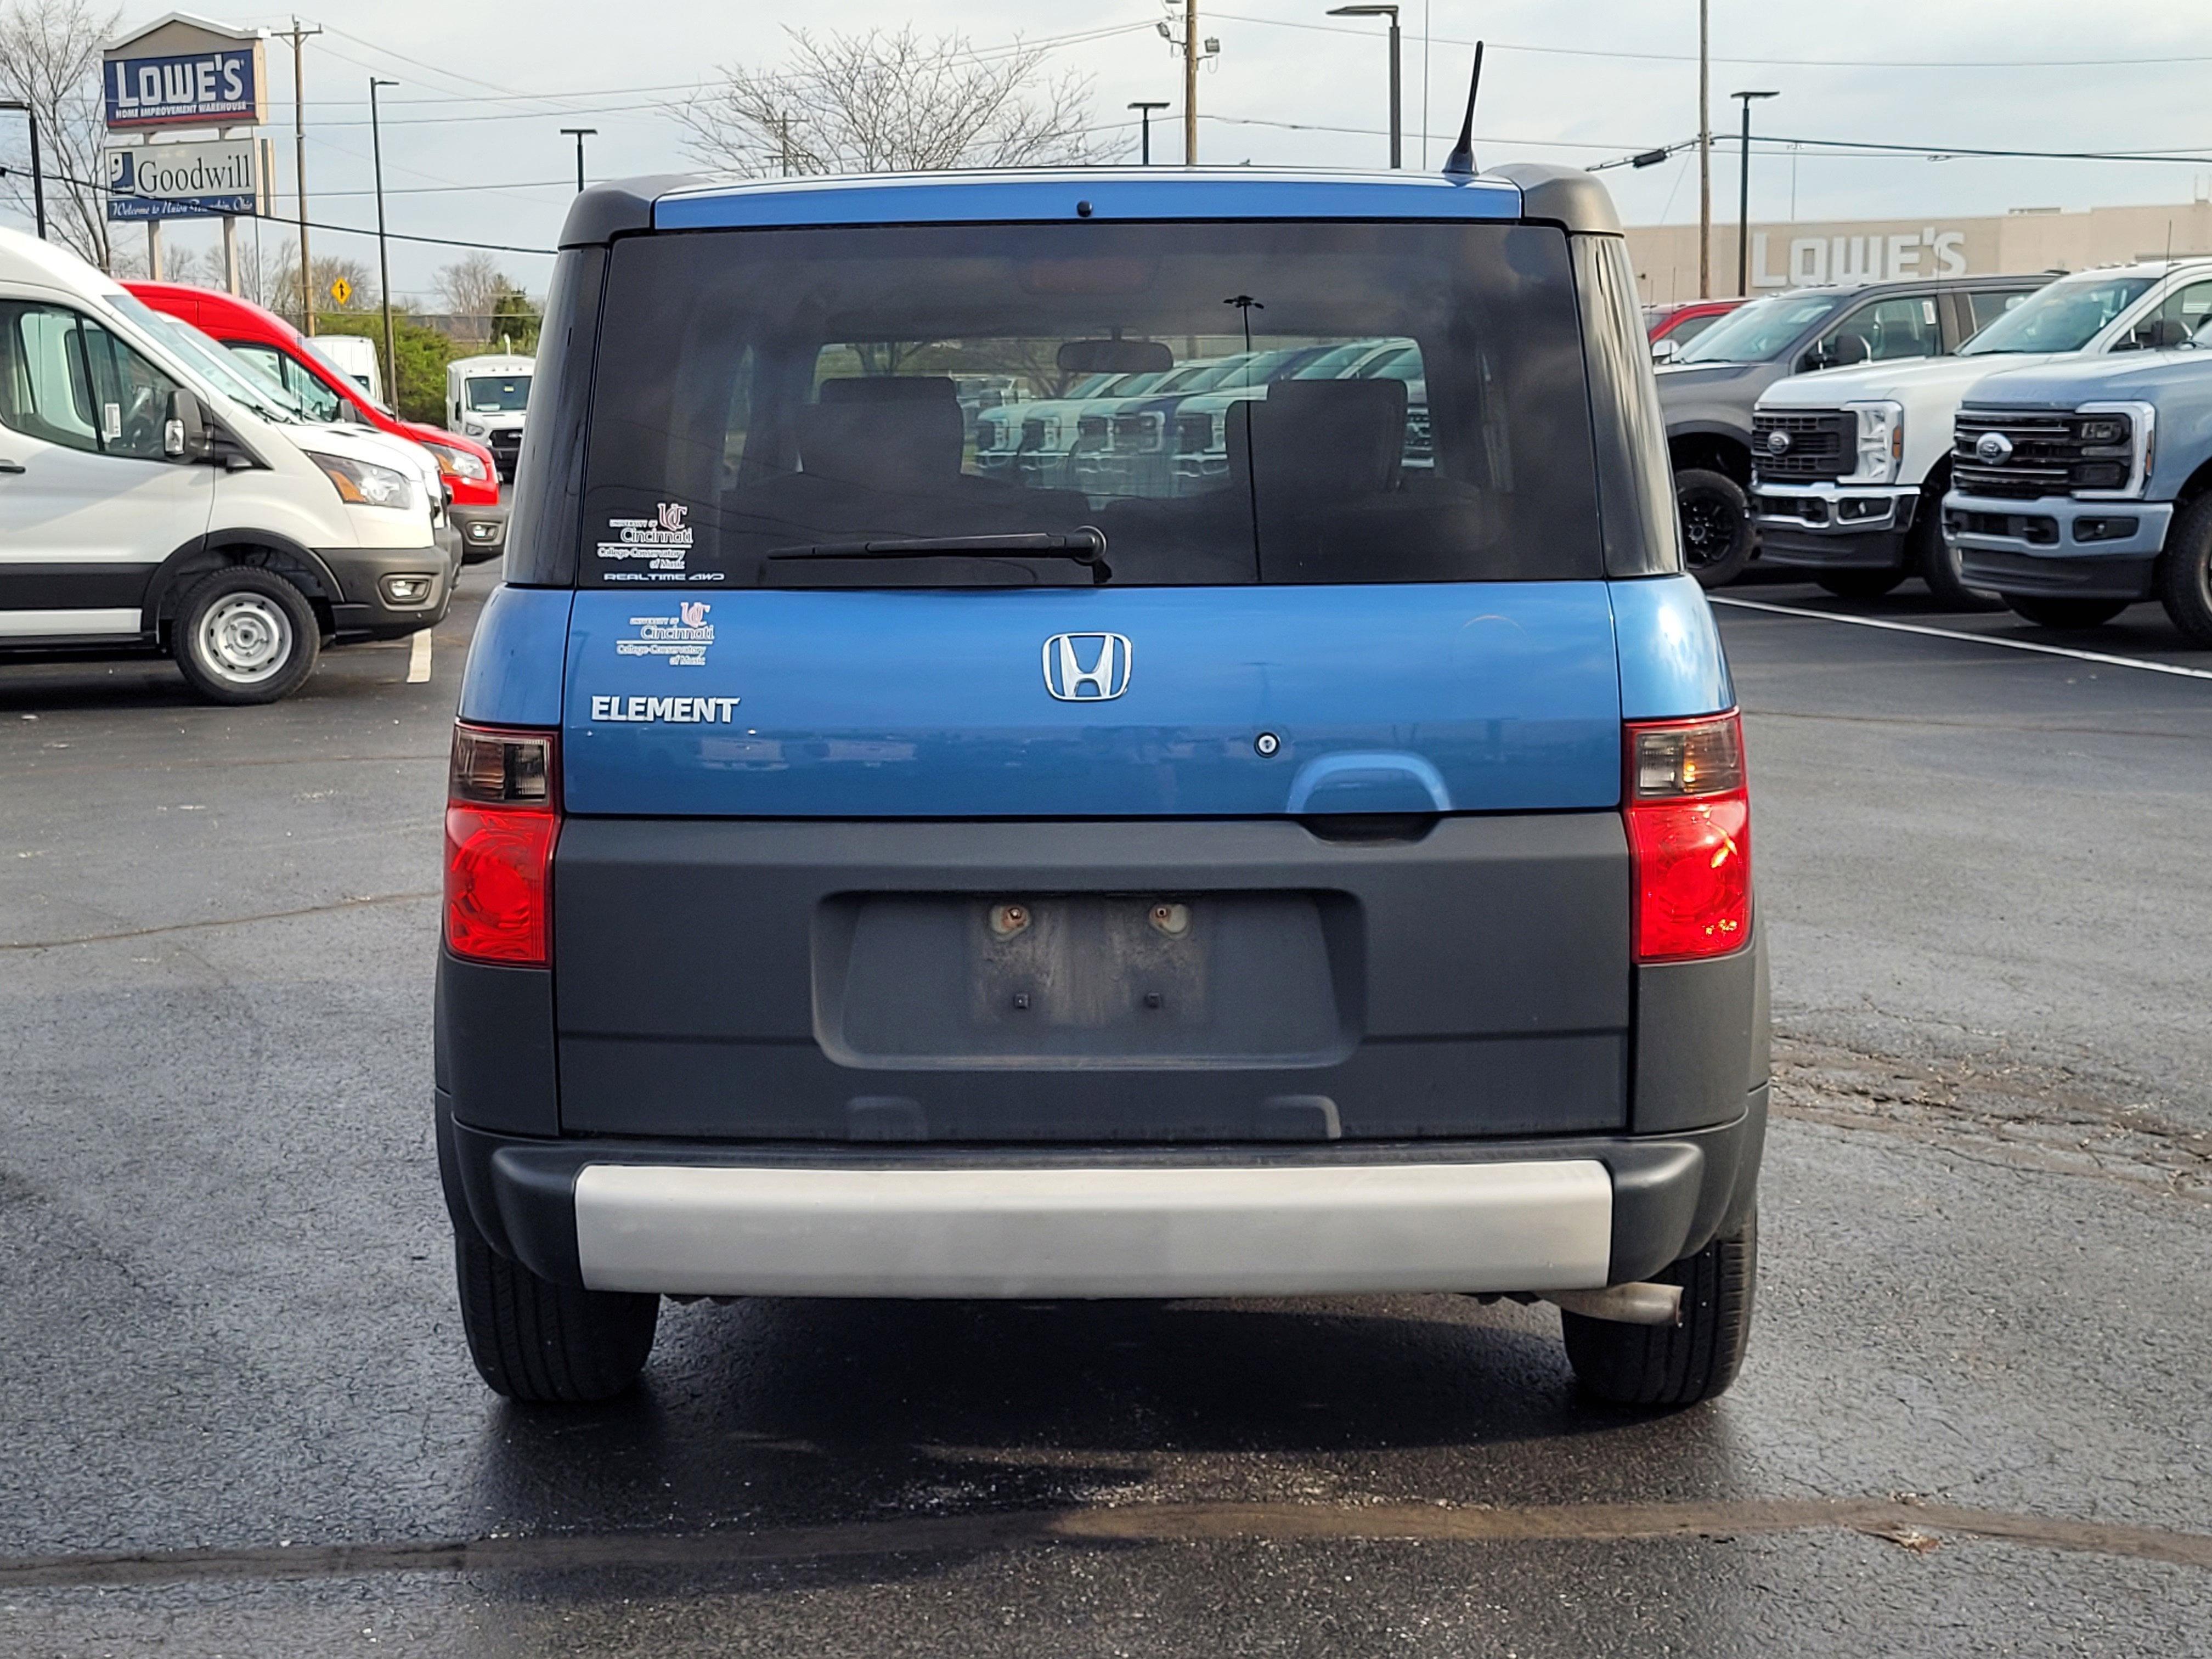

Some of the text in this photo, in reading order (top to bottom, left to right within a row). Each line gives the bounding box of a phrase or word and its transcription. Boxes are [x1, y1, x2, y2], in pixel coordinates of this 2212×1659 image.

[116, 54, 243, 108] LOWE'S
[116, 100, 246, 119] HOME IMPROVEMENT WAREHOUSE
[138, 154, 251, 193] Goodwill
[112, 202, 149, 216] Welcome
[152, 204, 159, 214] to
[1752, 227, 1967, 288] LOWE'S
[620, 527, 693, 543] Cincinnati
[640, 624, 714, 640] Cincinnati
[591, 696, 741, 723] ELEMENT
